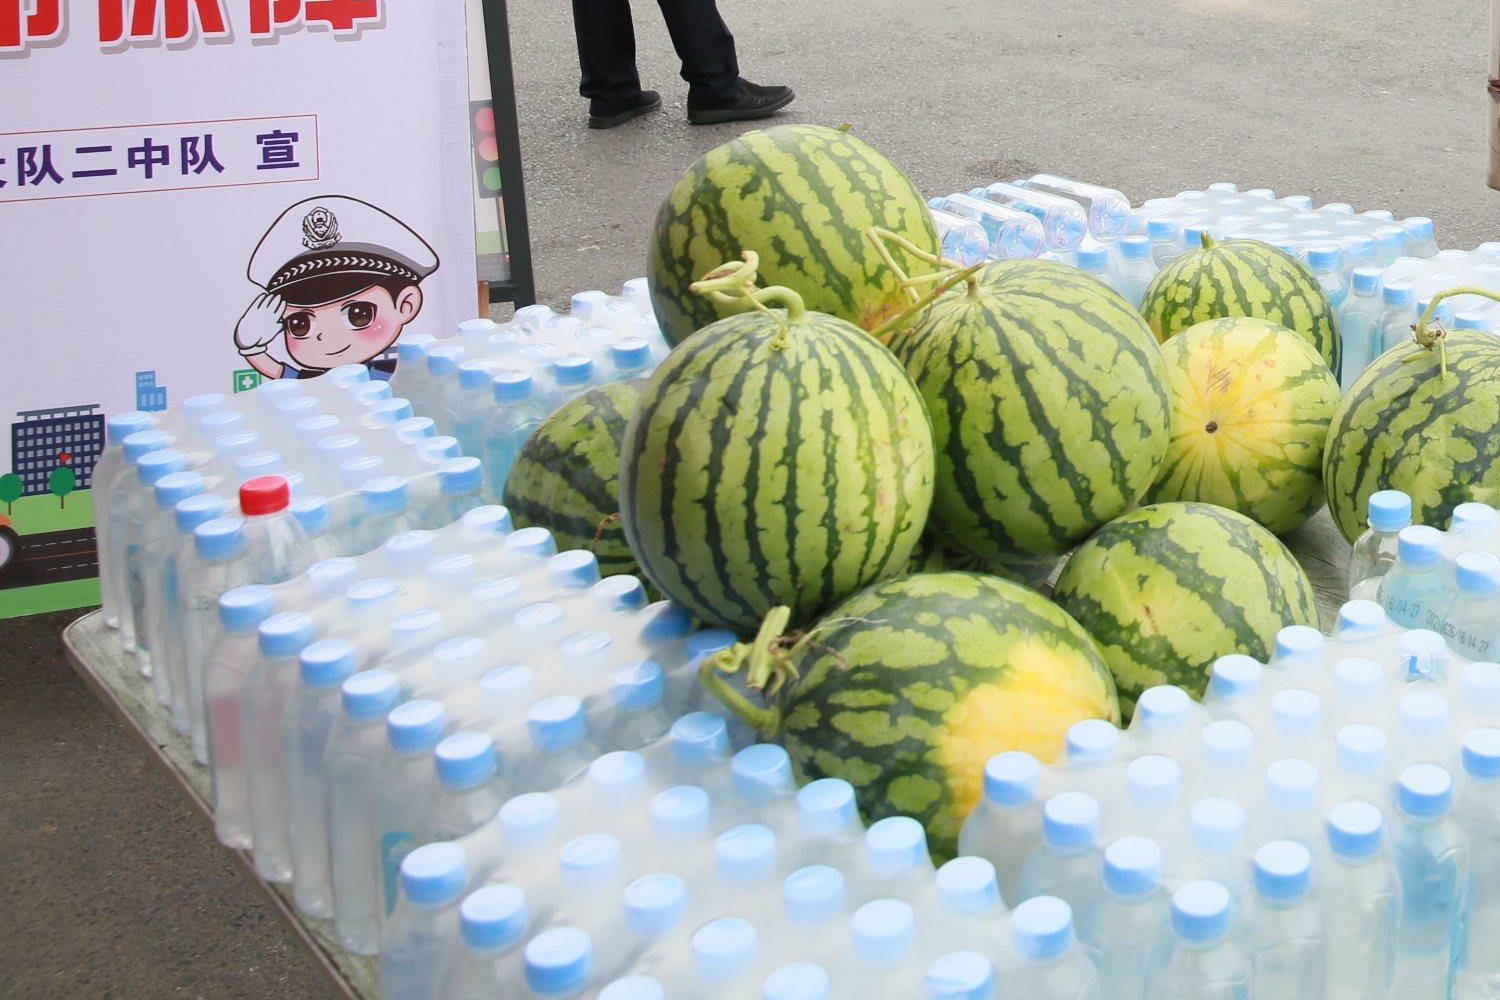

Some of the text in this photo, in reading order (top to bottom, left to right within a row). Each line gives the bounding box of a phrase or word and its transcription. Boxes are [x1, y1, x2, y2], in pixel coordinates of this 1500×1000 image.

[0, 129, 300, 188] 队二中队 宣
